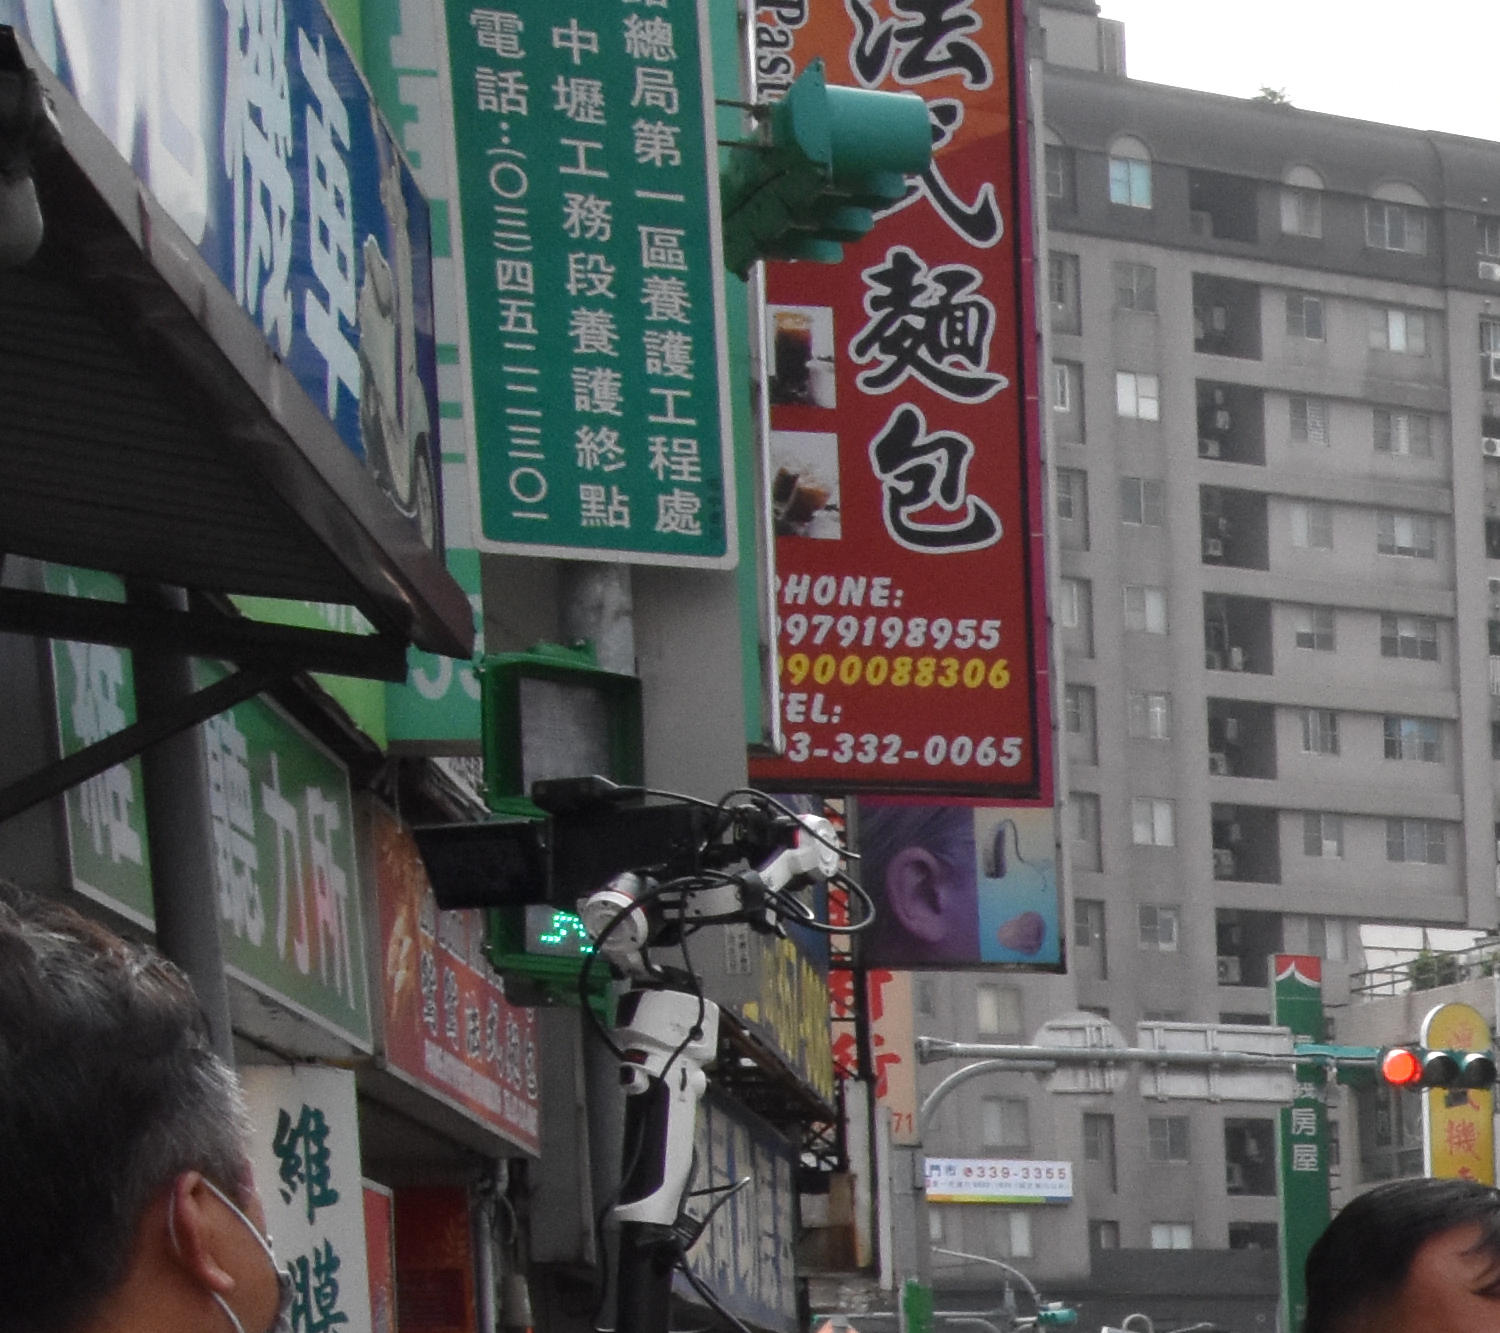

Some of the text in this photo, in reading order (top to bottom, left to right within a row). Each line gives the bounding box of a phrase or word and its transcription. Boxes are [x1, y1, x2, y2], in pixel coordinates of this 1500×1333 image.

[552, 18, 631, 529] 中壢工務段養護終點
[622, 0, 702, 536] 總局第一區養護工程處
[774, 573, 904, 608] HONE:
[775, 613, 1002, 649] 979198955
[777, 652, 1011, 689] 900088306
[780, 732, 1023, 767] 3-332-0065
